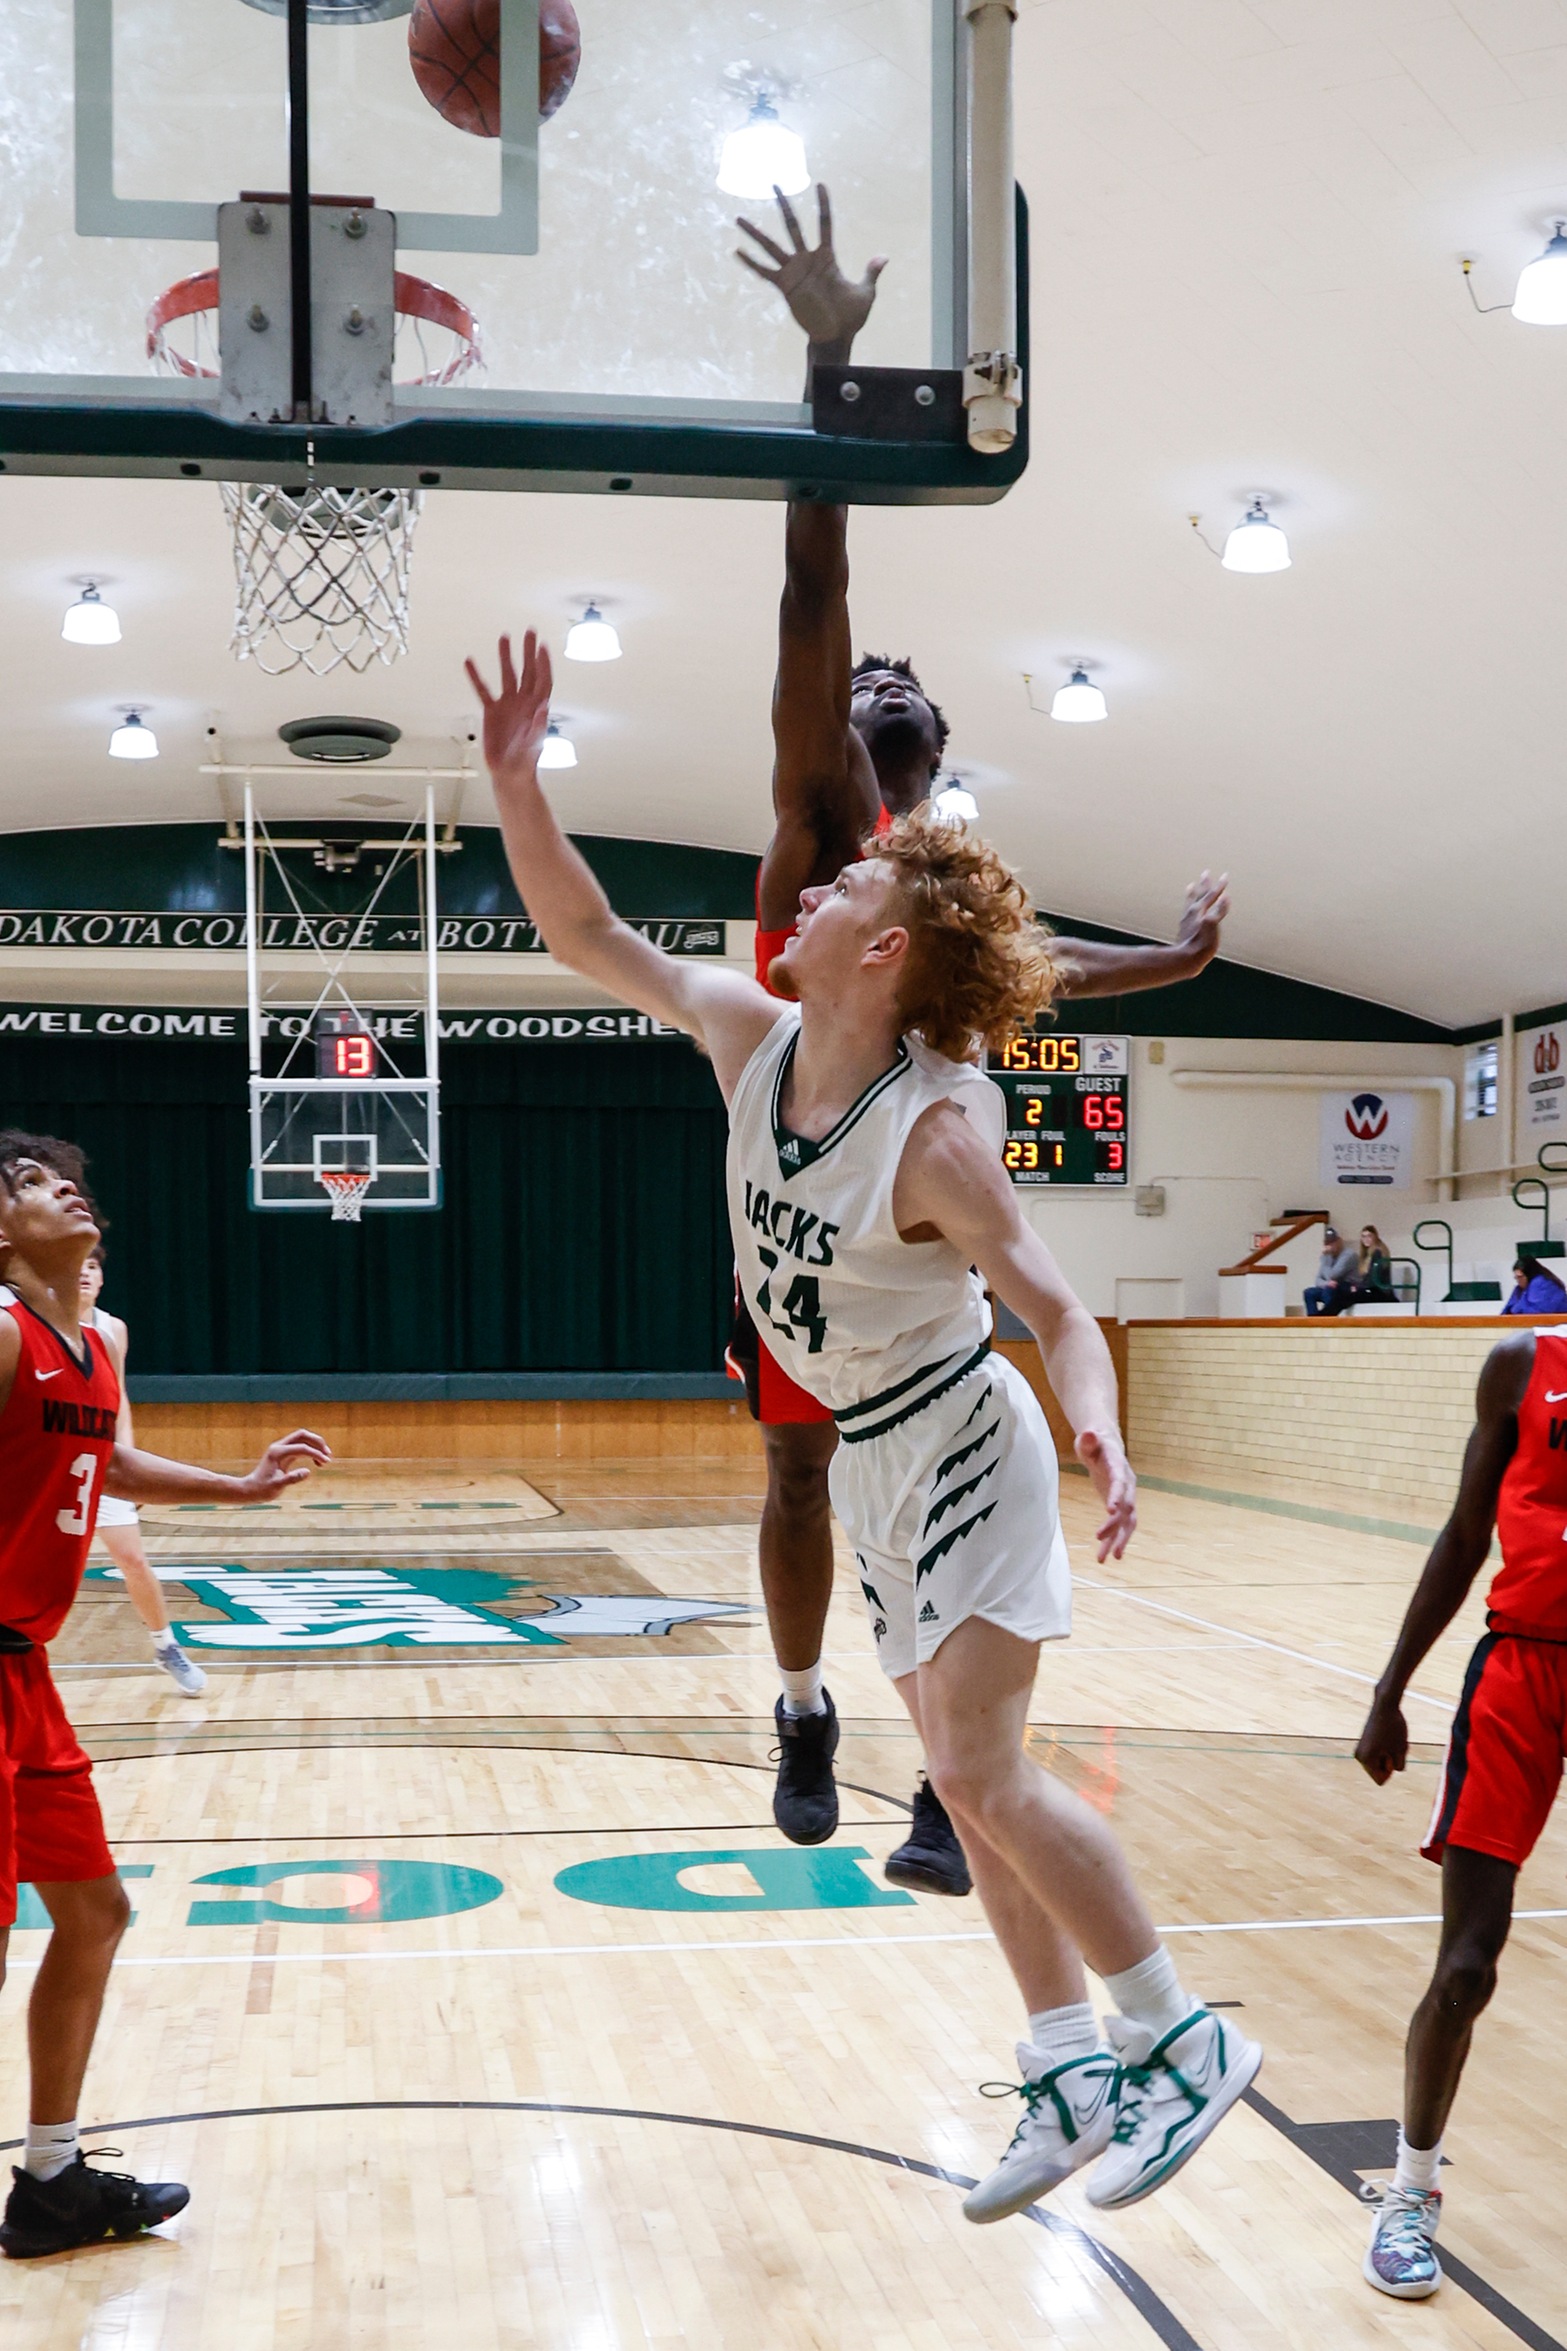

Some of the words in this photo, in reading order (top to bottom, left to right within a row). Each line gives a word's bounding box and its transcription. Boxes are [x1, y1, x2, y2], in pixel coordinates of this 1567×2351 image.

[0, 915, 162, 944] DAKOTA
[387, 929, 426, 941] AT
[0, 1011, 236, 1036] WELCOME
[437, 1016, 678, 1038] WOODSHE
[336, 1036, 371, 1076] 13
[1002, 1038, 1080, 1071] 15:05
[1015, 1084, 1052, 1095] PERIOD
[1075, 1077, 1122, 1092] GUEST
[1025, 1098, 1043, 1125] 2
[1084, 1095, 1124, 1129] 65
[1006, 1130, 1037, 1140] LAYER
[1333, 1143, 1400, 1154] WESTERN
[1005, 1141, 1039, 1168] 23
[1055, 1144, 1063, 1166] 1
[1107, 1141, 1123, 1169] 3
[744, 1179, 841, 1267] JACKS
[55, 1452, 97, 1536] 3
